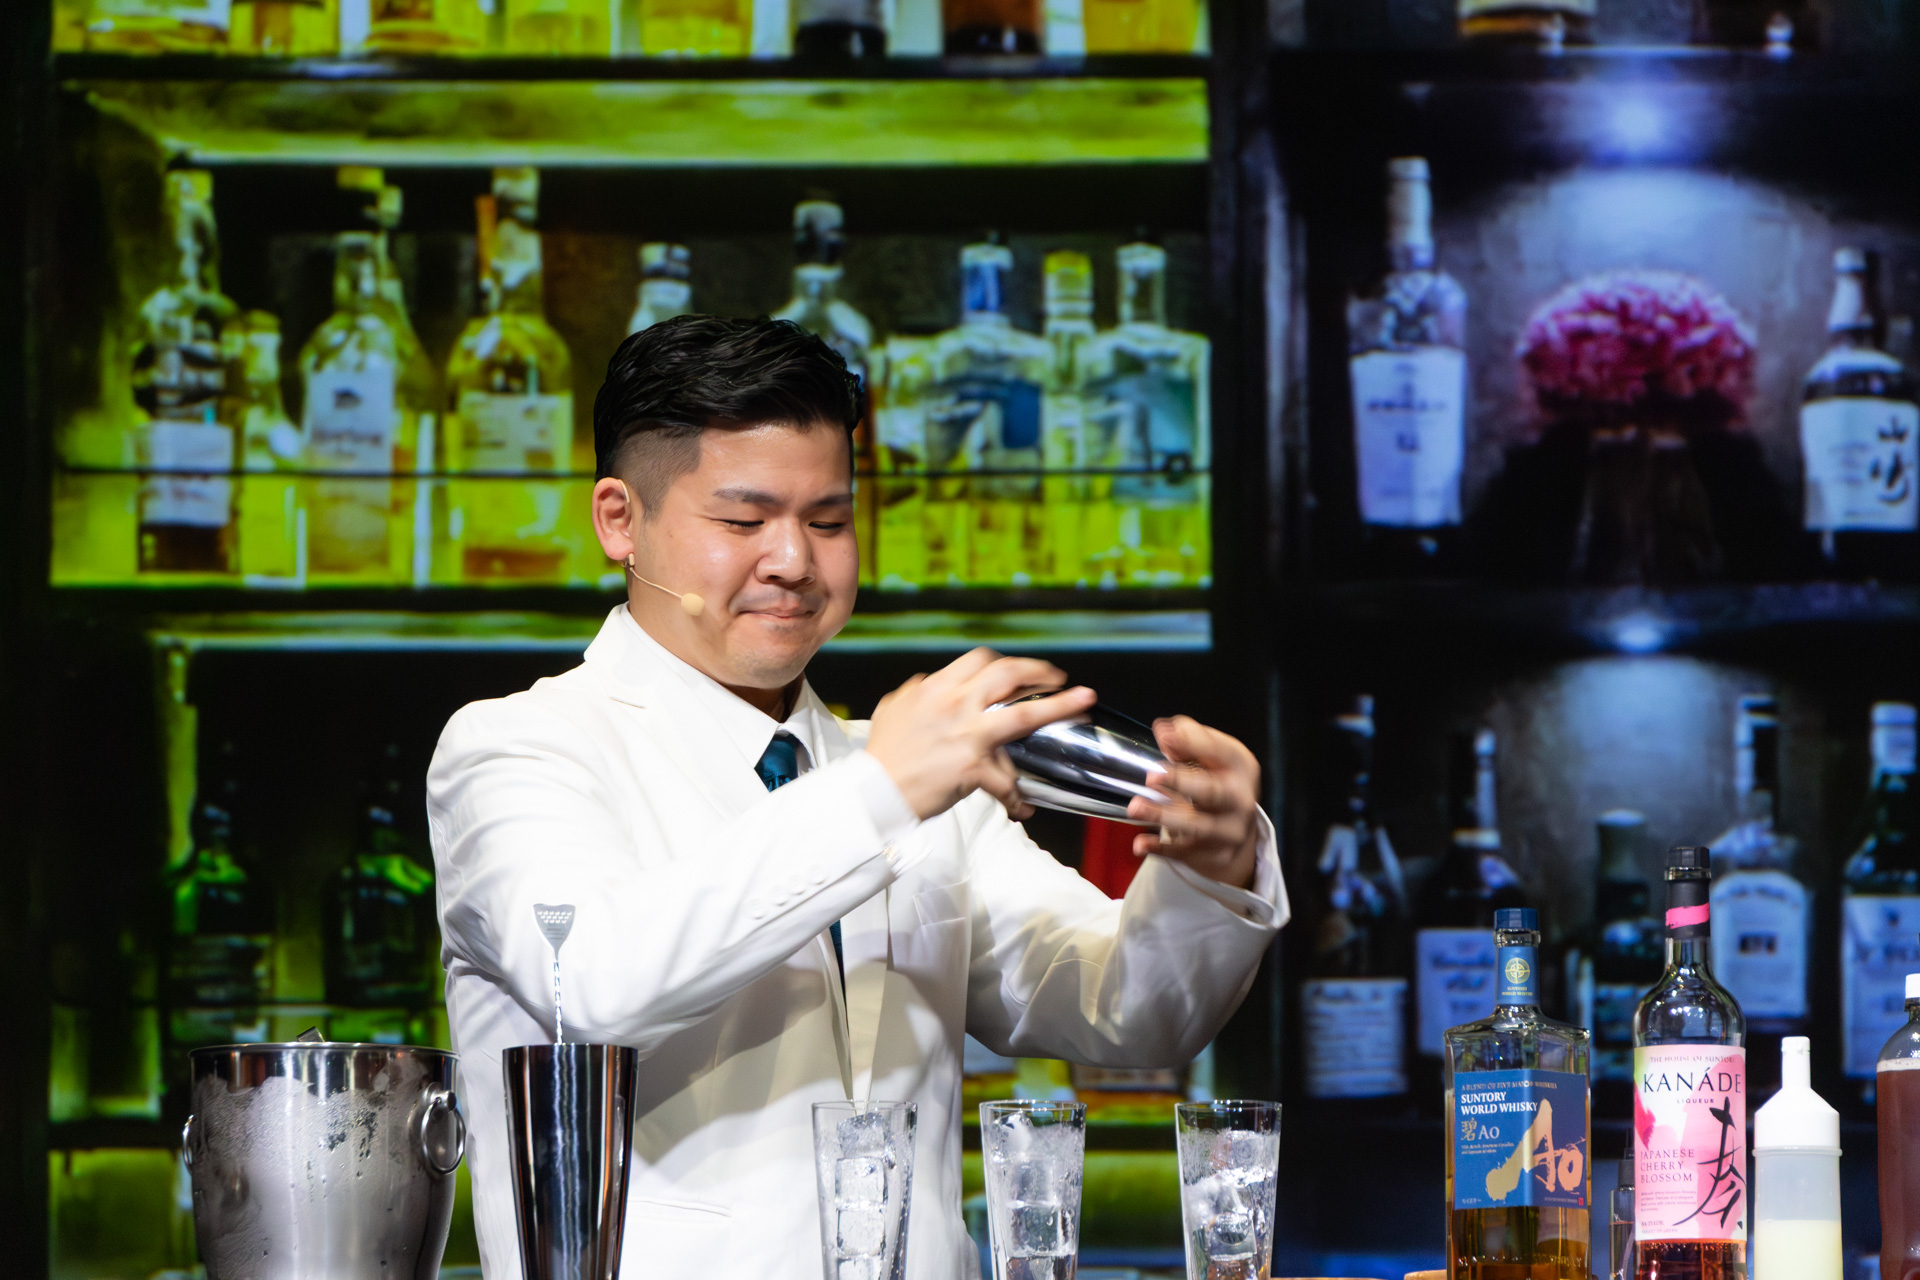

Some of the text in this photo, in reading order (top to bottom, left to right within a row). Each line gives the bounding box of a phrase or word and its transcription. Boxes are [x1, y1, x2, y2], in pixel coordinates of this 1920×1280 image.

[1643, 1066, 1741, 1093] KANÁDE
[1461, 1091, 1507, 1104] SUNTORY
[1461, 1101, 1538, 1115] WORLD WHISKY
[1461, 1117, 1477, 1141] 碧
[1640, 1149, 1695, 1161] JAPANESE
[1640, 1160, 1684, 1172] CHERRY
[1640, 1173, 1693, 1184] BLOSSOM
